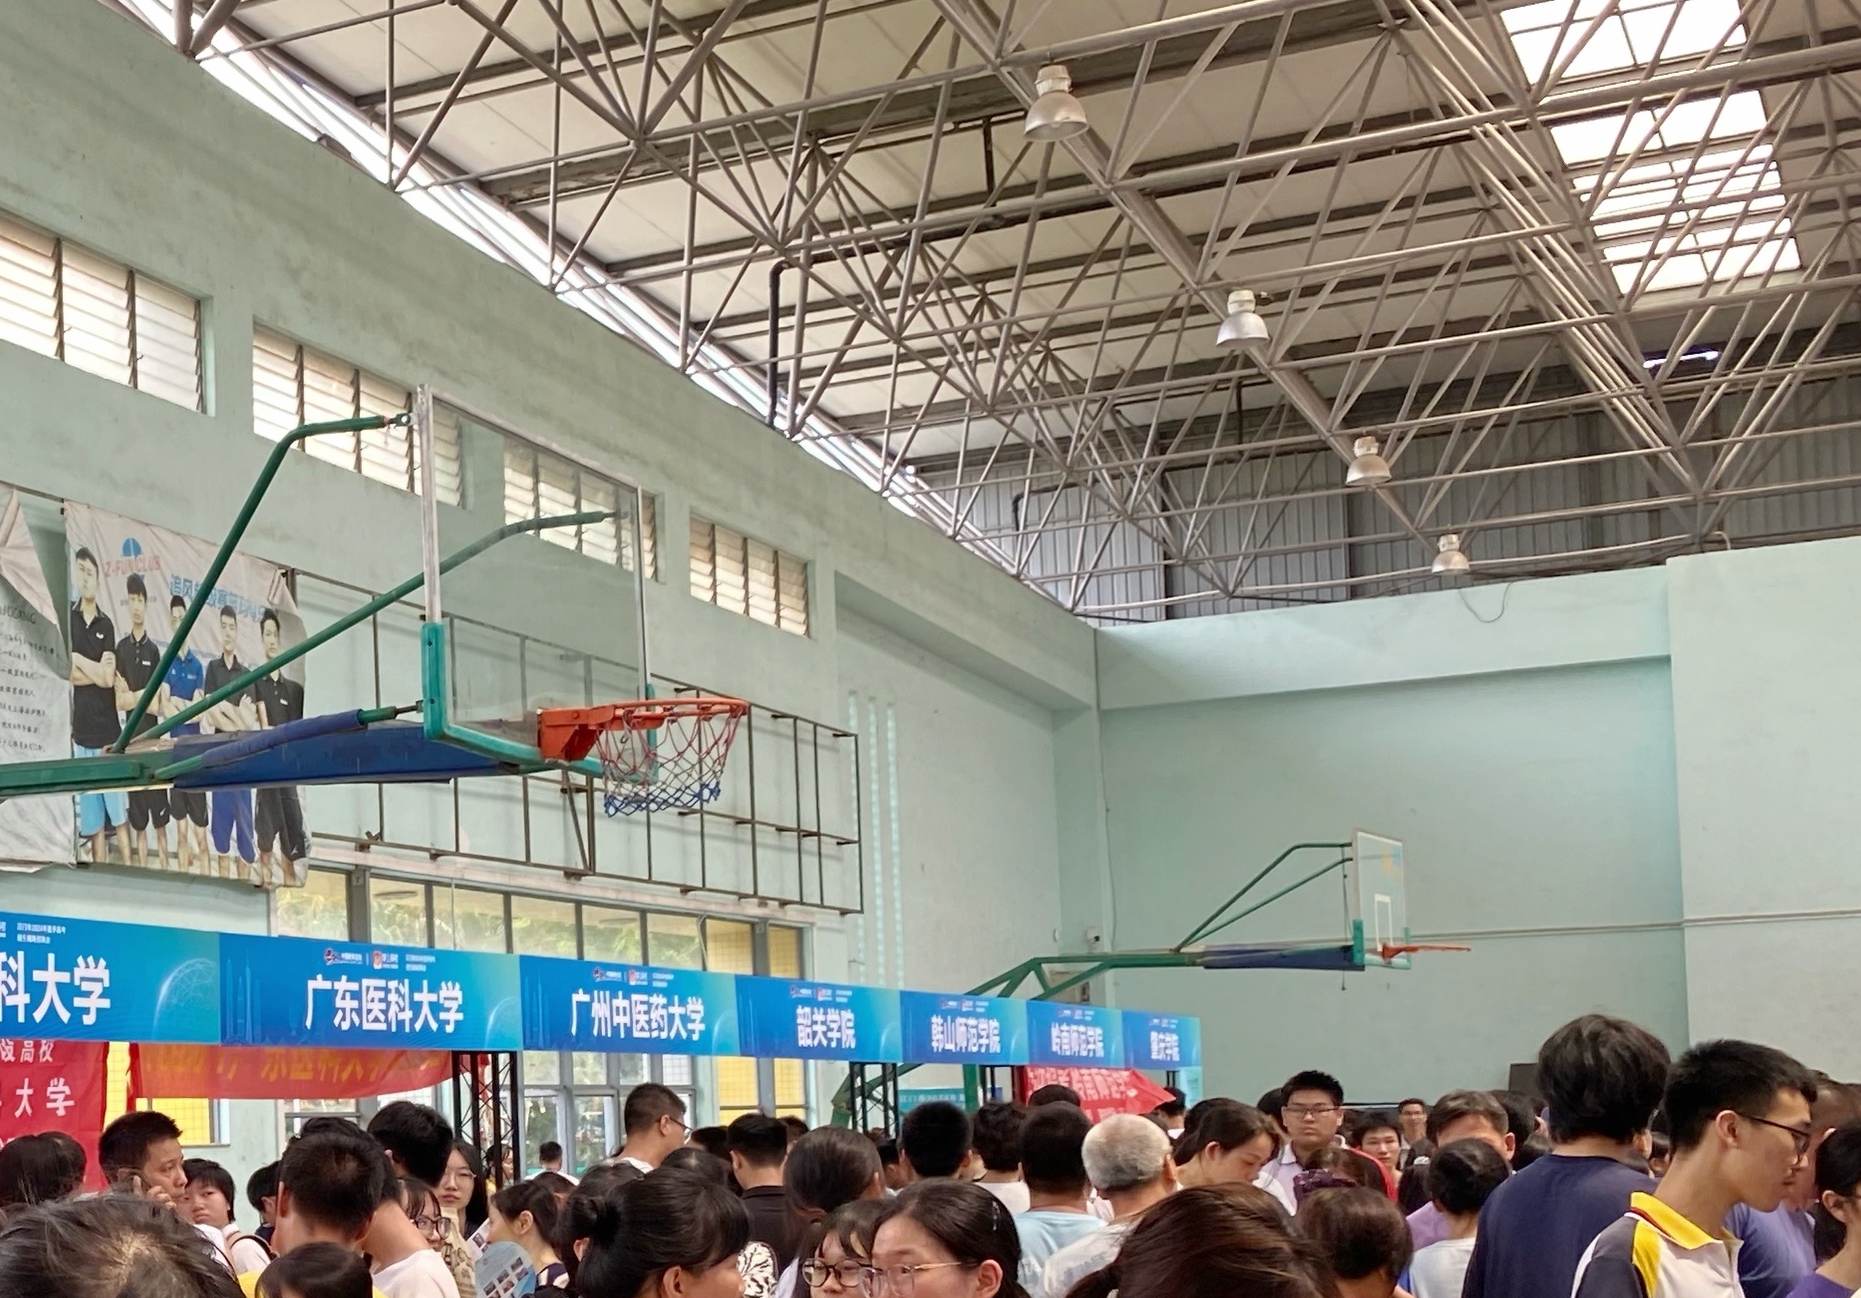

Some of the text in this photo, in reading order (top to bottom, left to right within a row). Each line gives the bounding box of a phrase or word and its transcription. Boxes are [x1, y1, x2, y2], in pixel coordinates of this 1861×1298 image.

[305, 974, 465, 1034] 广东医科大学
[571, 988, 706, 1041] 广州中医药大学
[796, 1005, 856, 1049] 韶关学院
[931, 1014, 1001, 1053] 韩山师范学院
